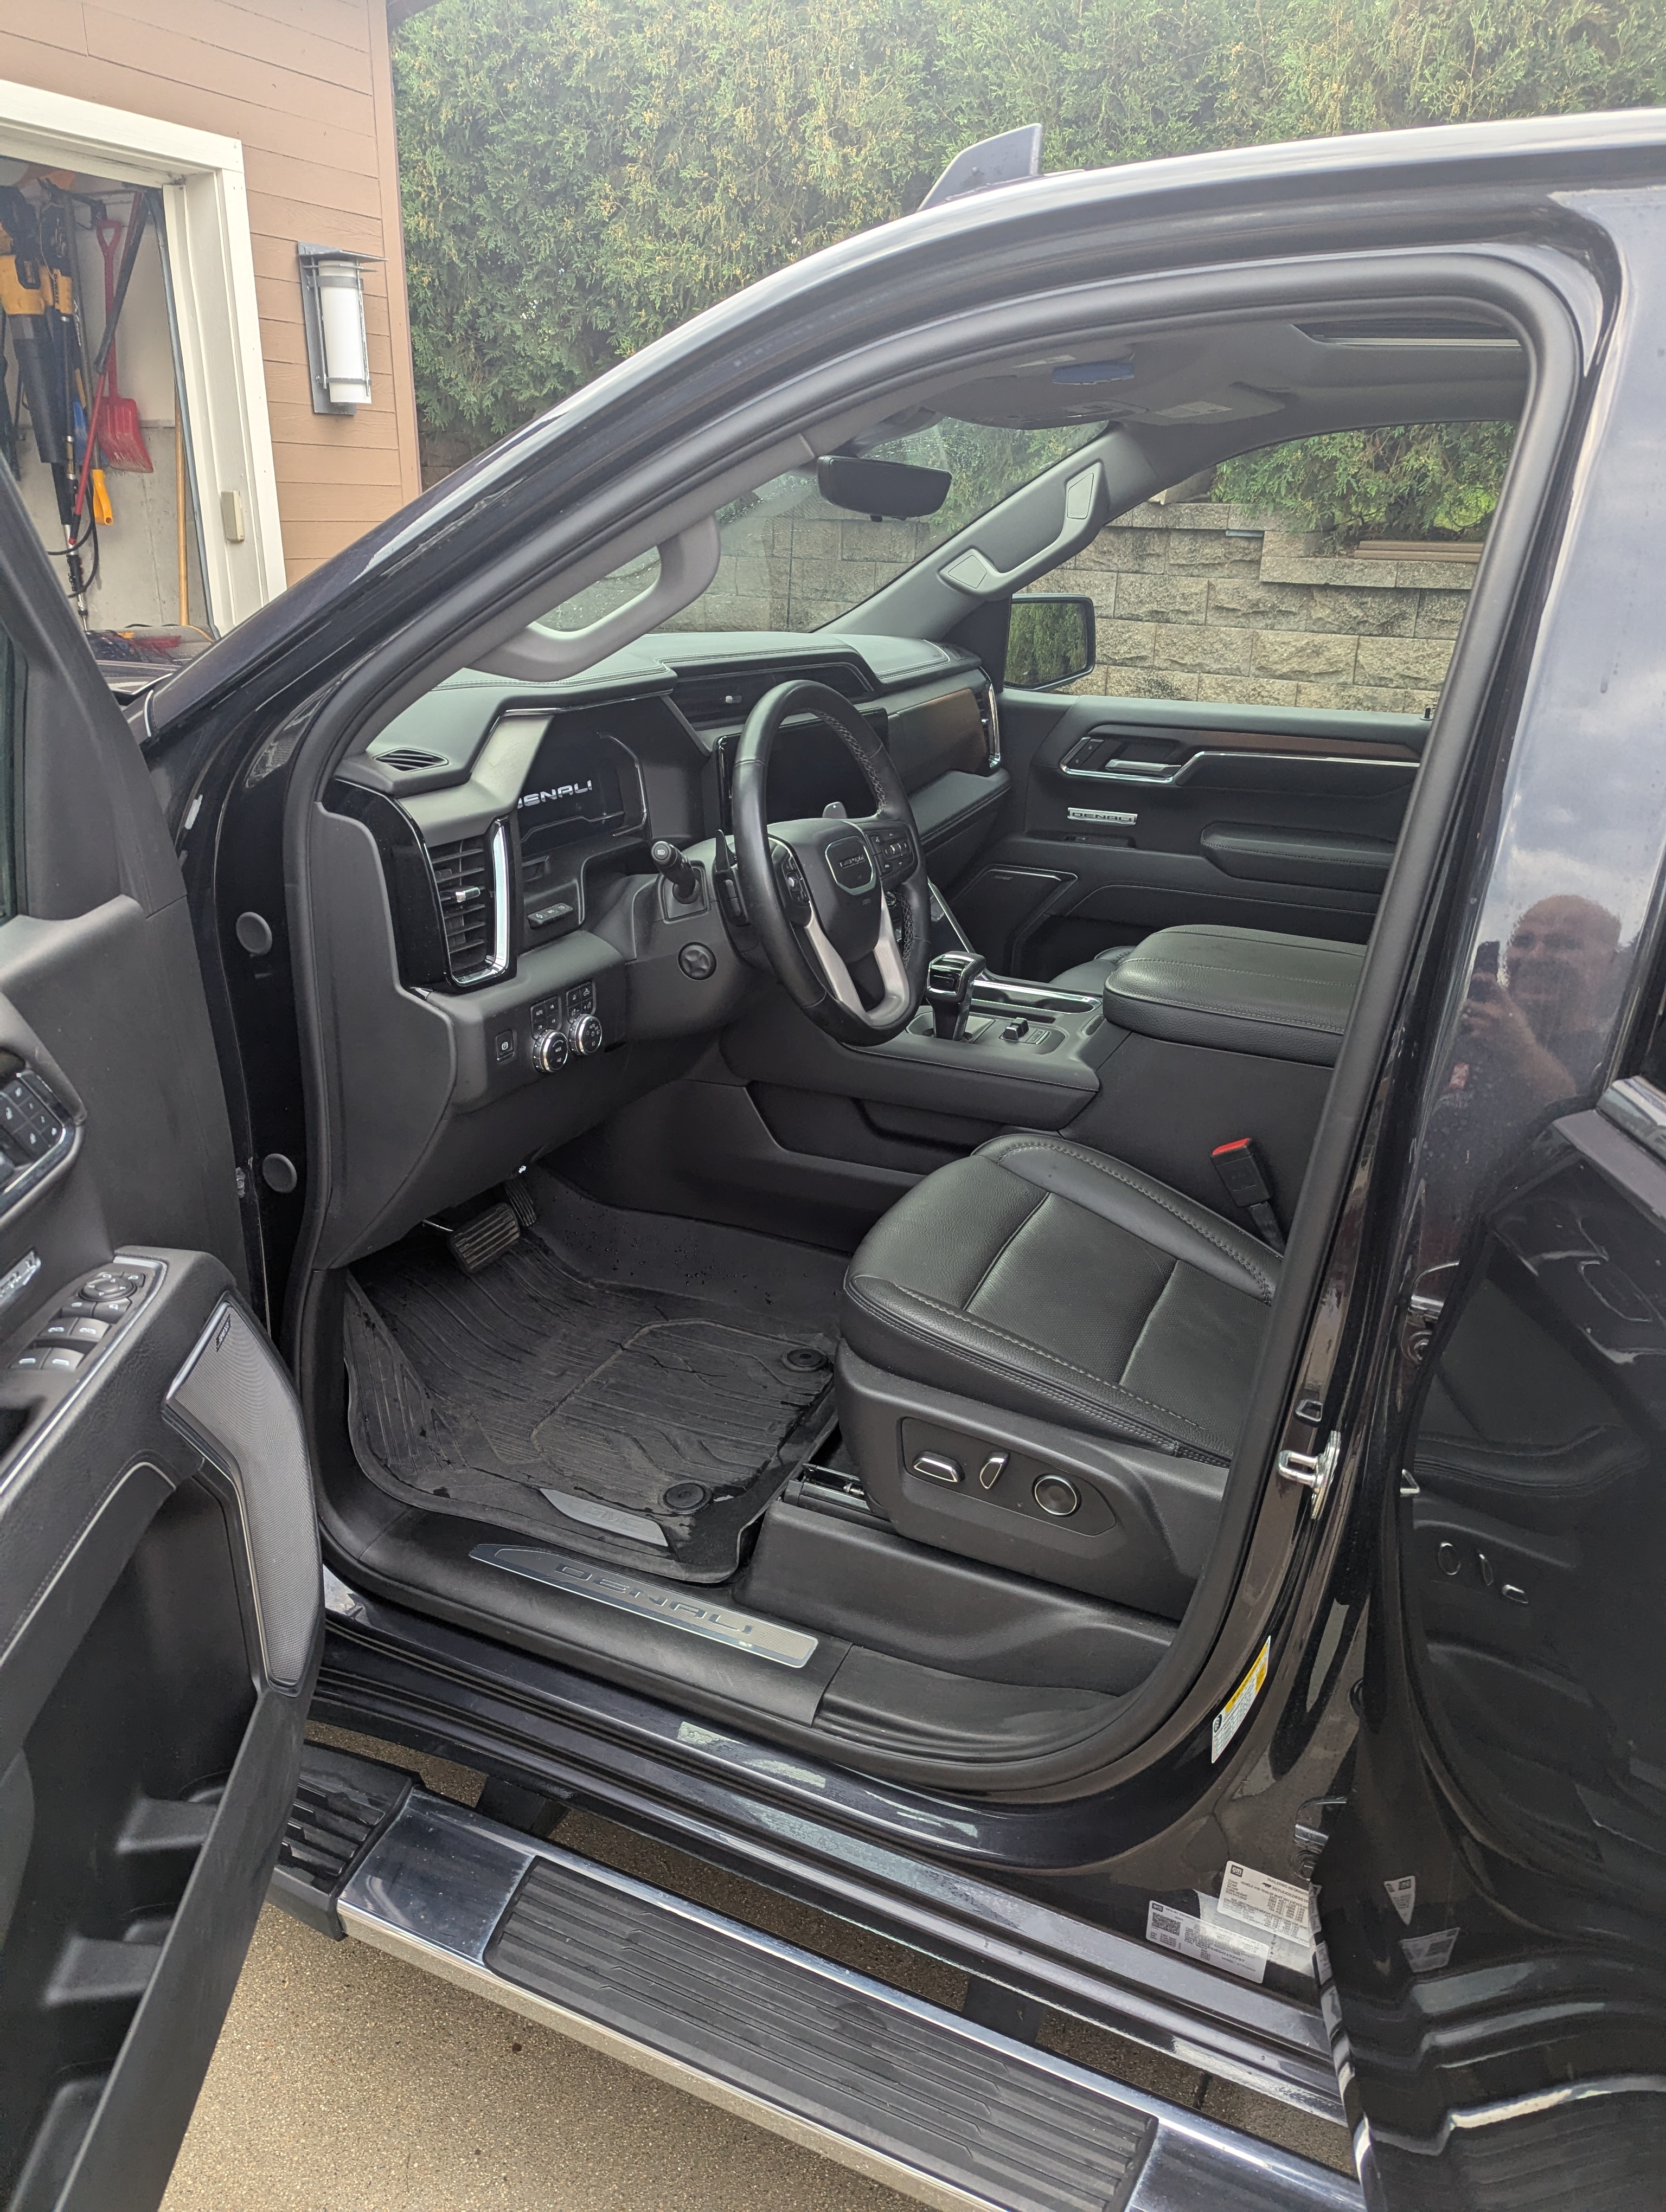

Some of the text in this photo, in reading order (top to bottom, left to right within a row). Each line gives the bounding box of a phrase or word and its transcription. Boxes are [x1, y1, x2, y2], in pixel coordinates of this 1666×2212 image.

[1072, 812, 1132, 822] DENALI
[584, 1505, 643, 1529] GMC
[554, 1562, 754, 1635] DENALI
[1267, 1877, 1287, 1888] TRAILERING
